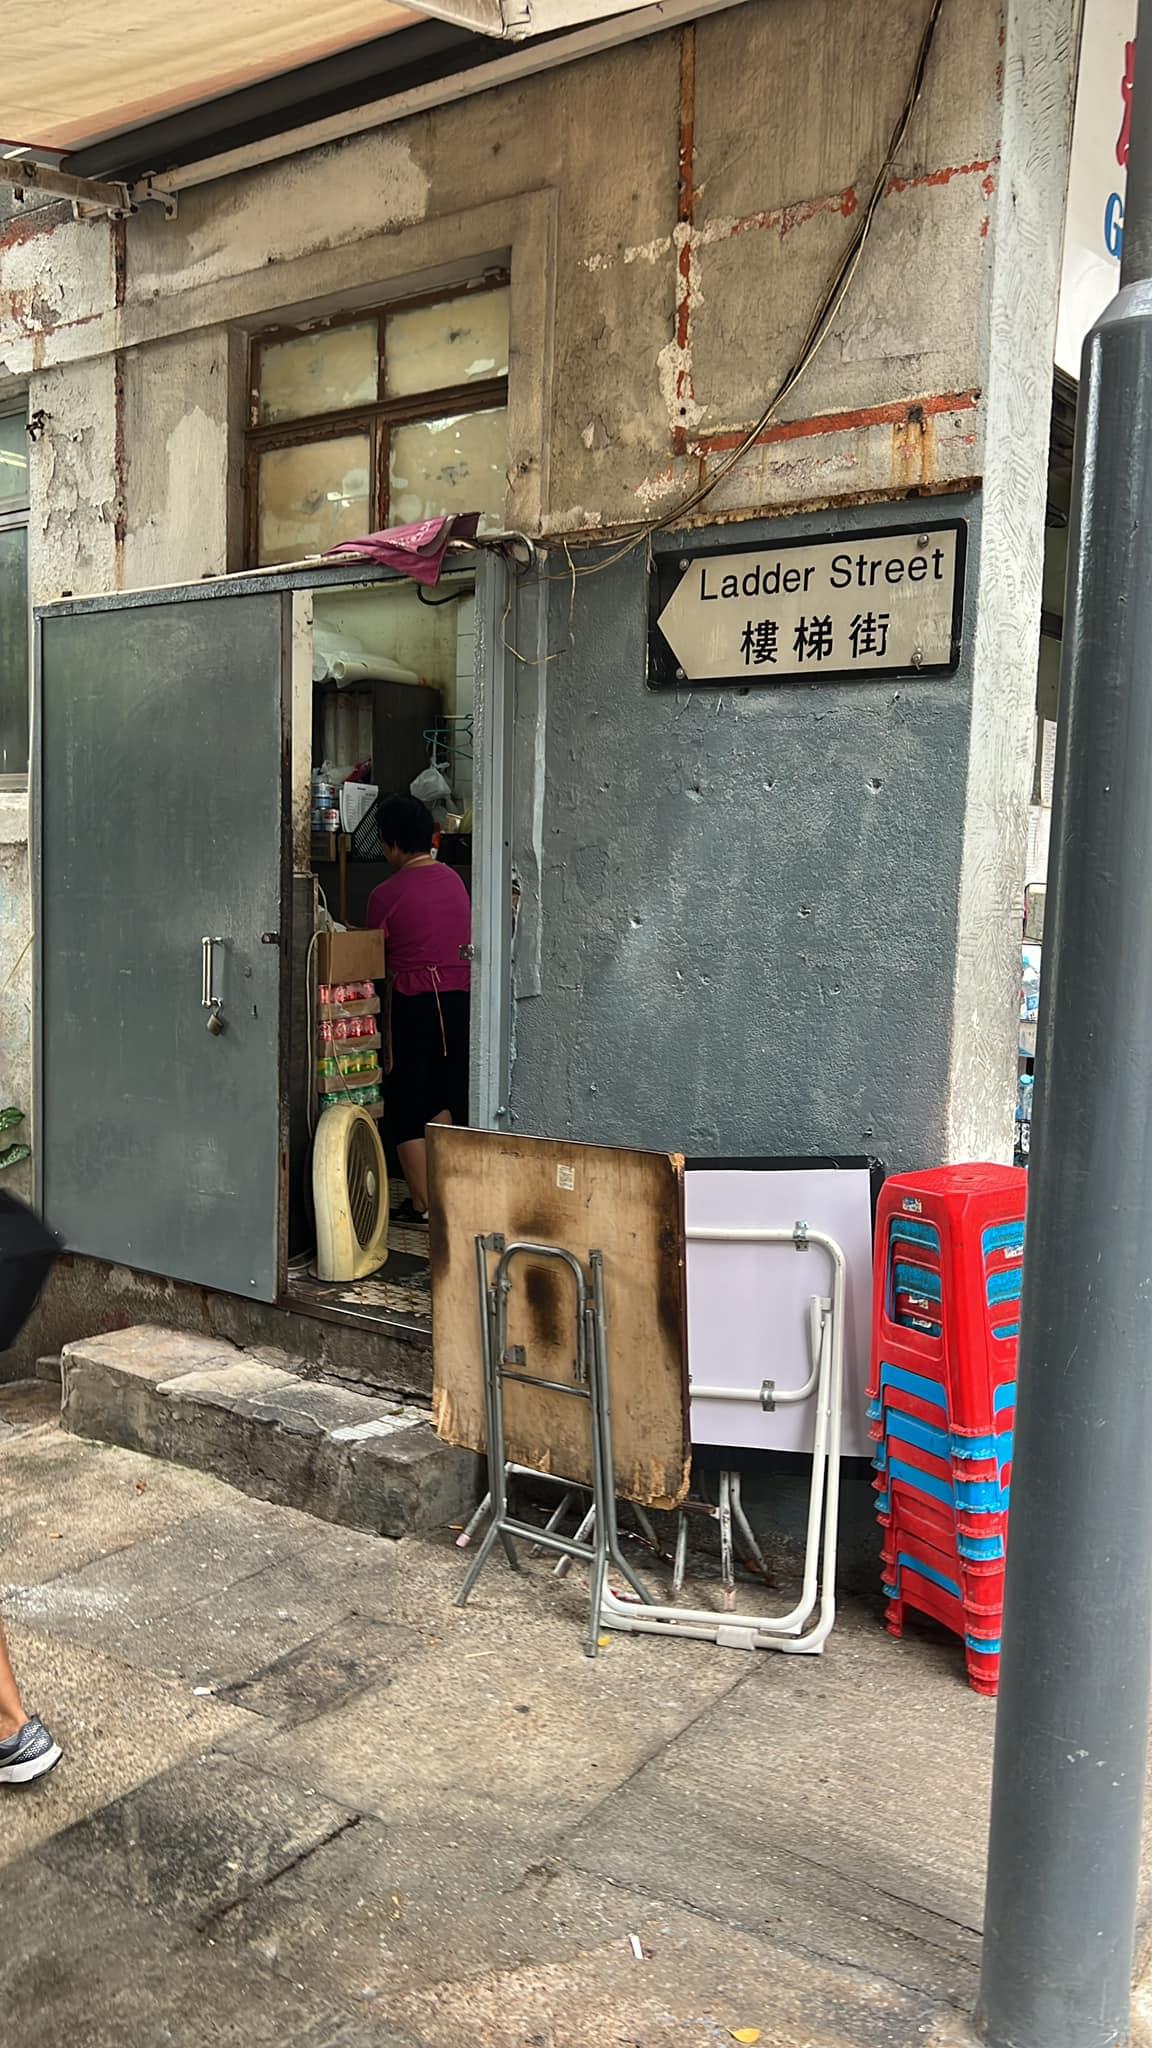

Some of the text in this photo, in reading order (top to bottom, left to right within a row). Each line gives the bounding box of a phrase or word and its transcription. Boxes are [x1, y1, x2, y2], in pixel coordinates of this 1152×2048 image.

[700, 548, 945, 601] Ladder Street
[740, 611, 891, 665] 樓梯街
